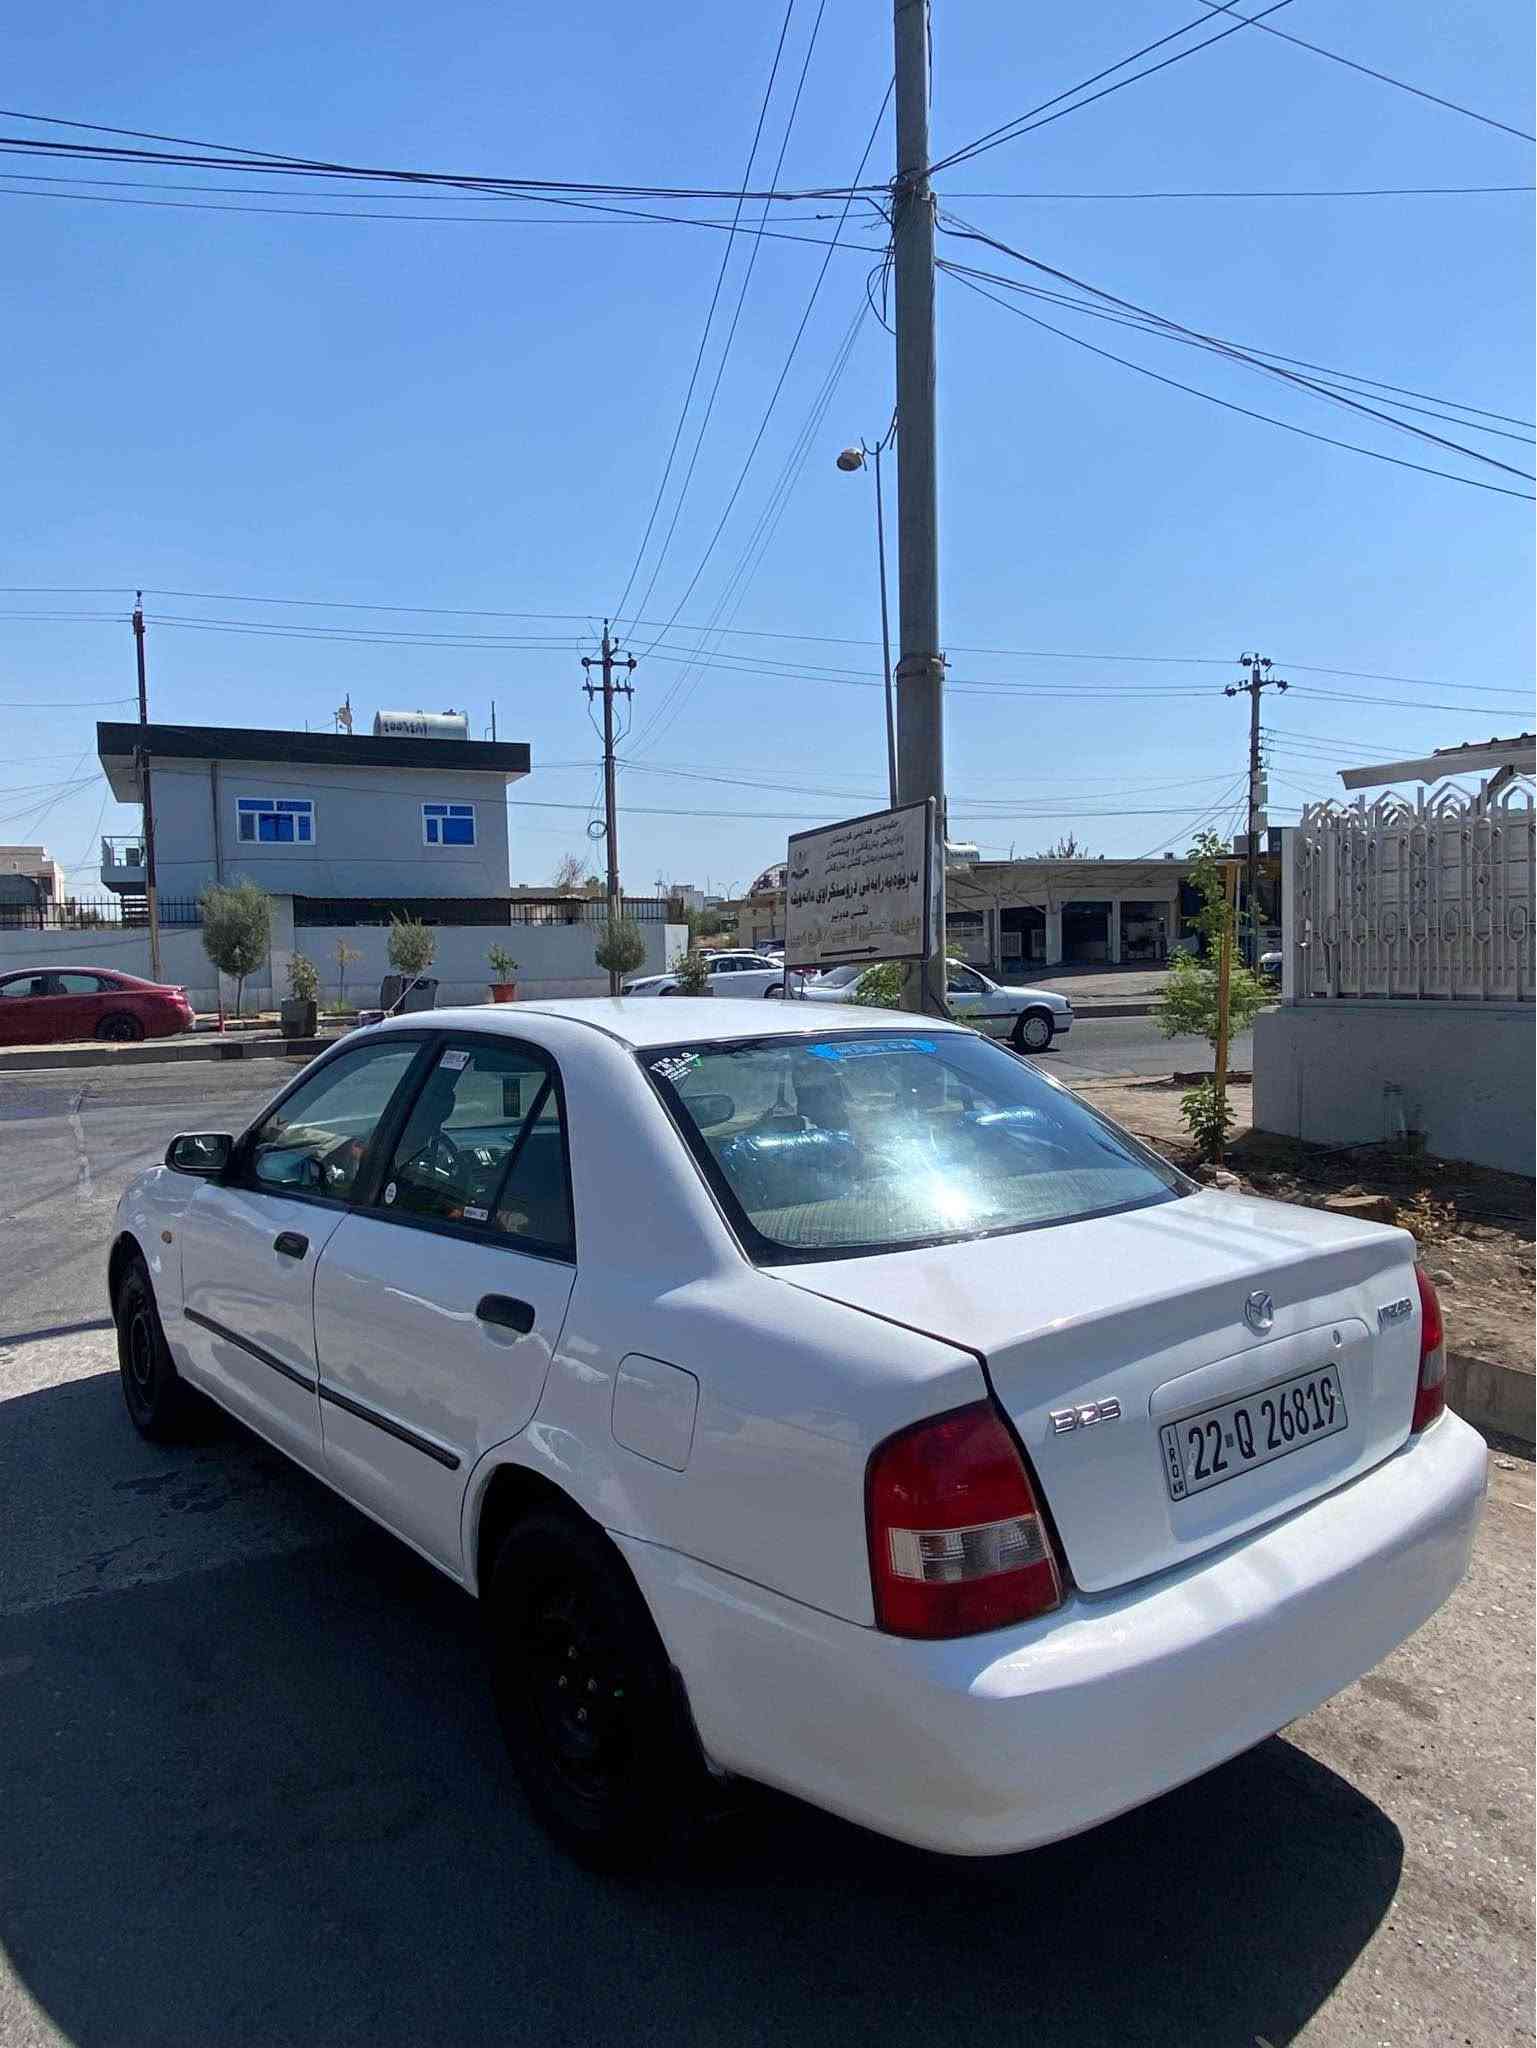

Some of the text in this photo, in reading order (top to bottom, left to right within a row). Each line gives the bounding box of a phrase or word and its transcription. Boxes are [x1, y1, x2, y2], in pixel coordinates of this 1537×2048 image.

[1188, 1376, 1336, 1480] 22 Q 26819
